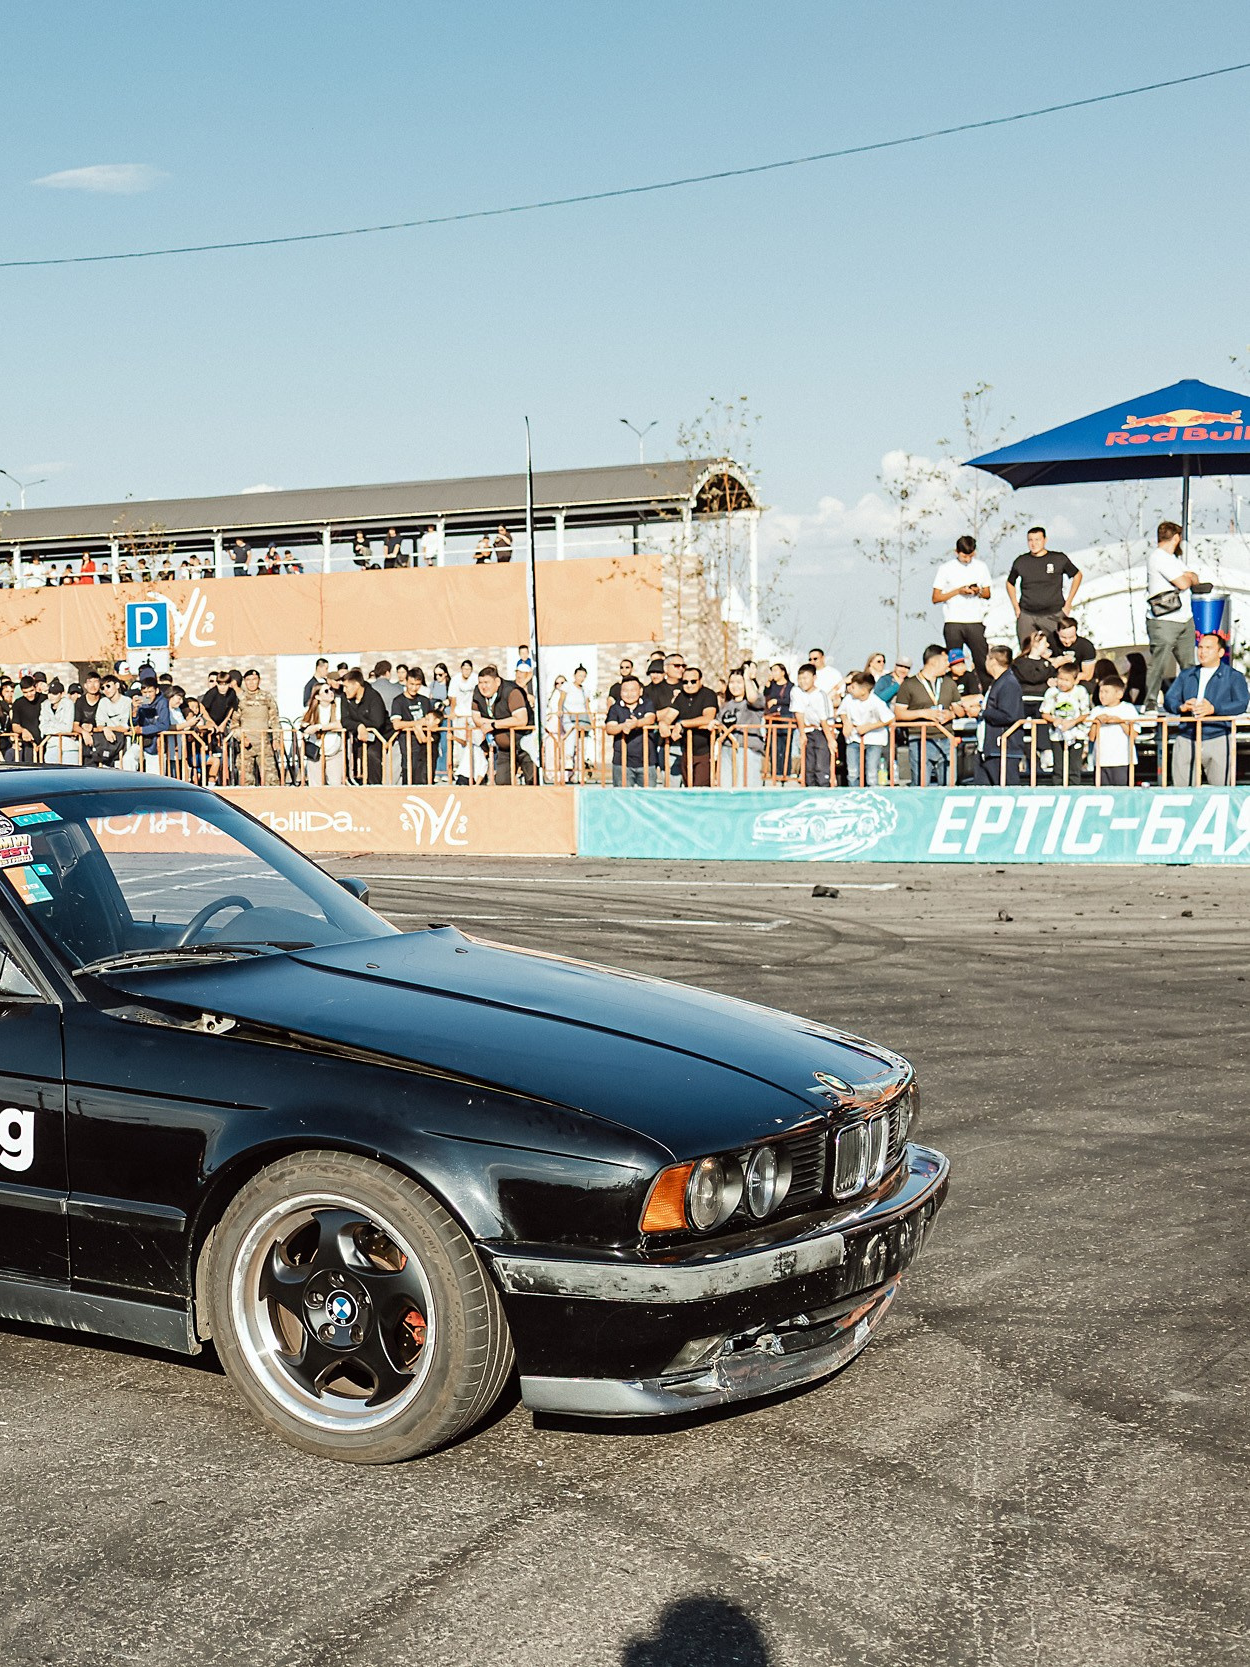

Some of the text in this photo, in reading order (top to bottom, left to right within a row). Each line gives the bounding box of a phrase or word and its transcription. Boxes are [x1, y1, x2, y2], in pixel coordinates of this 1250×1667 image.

[1105, 426, 1250, 446] Red Bull
[135, 606, 159, 644] P
